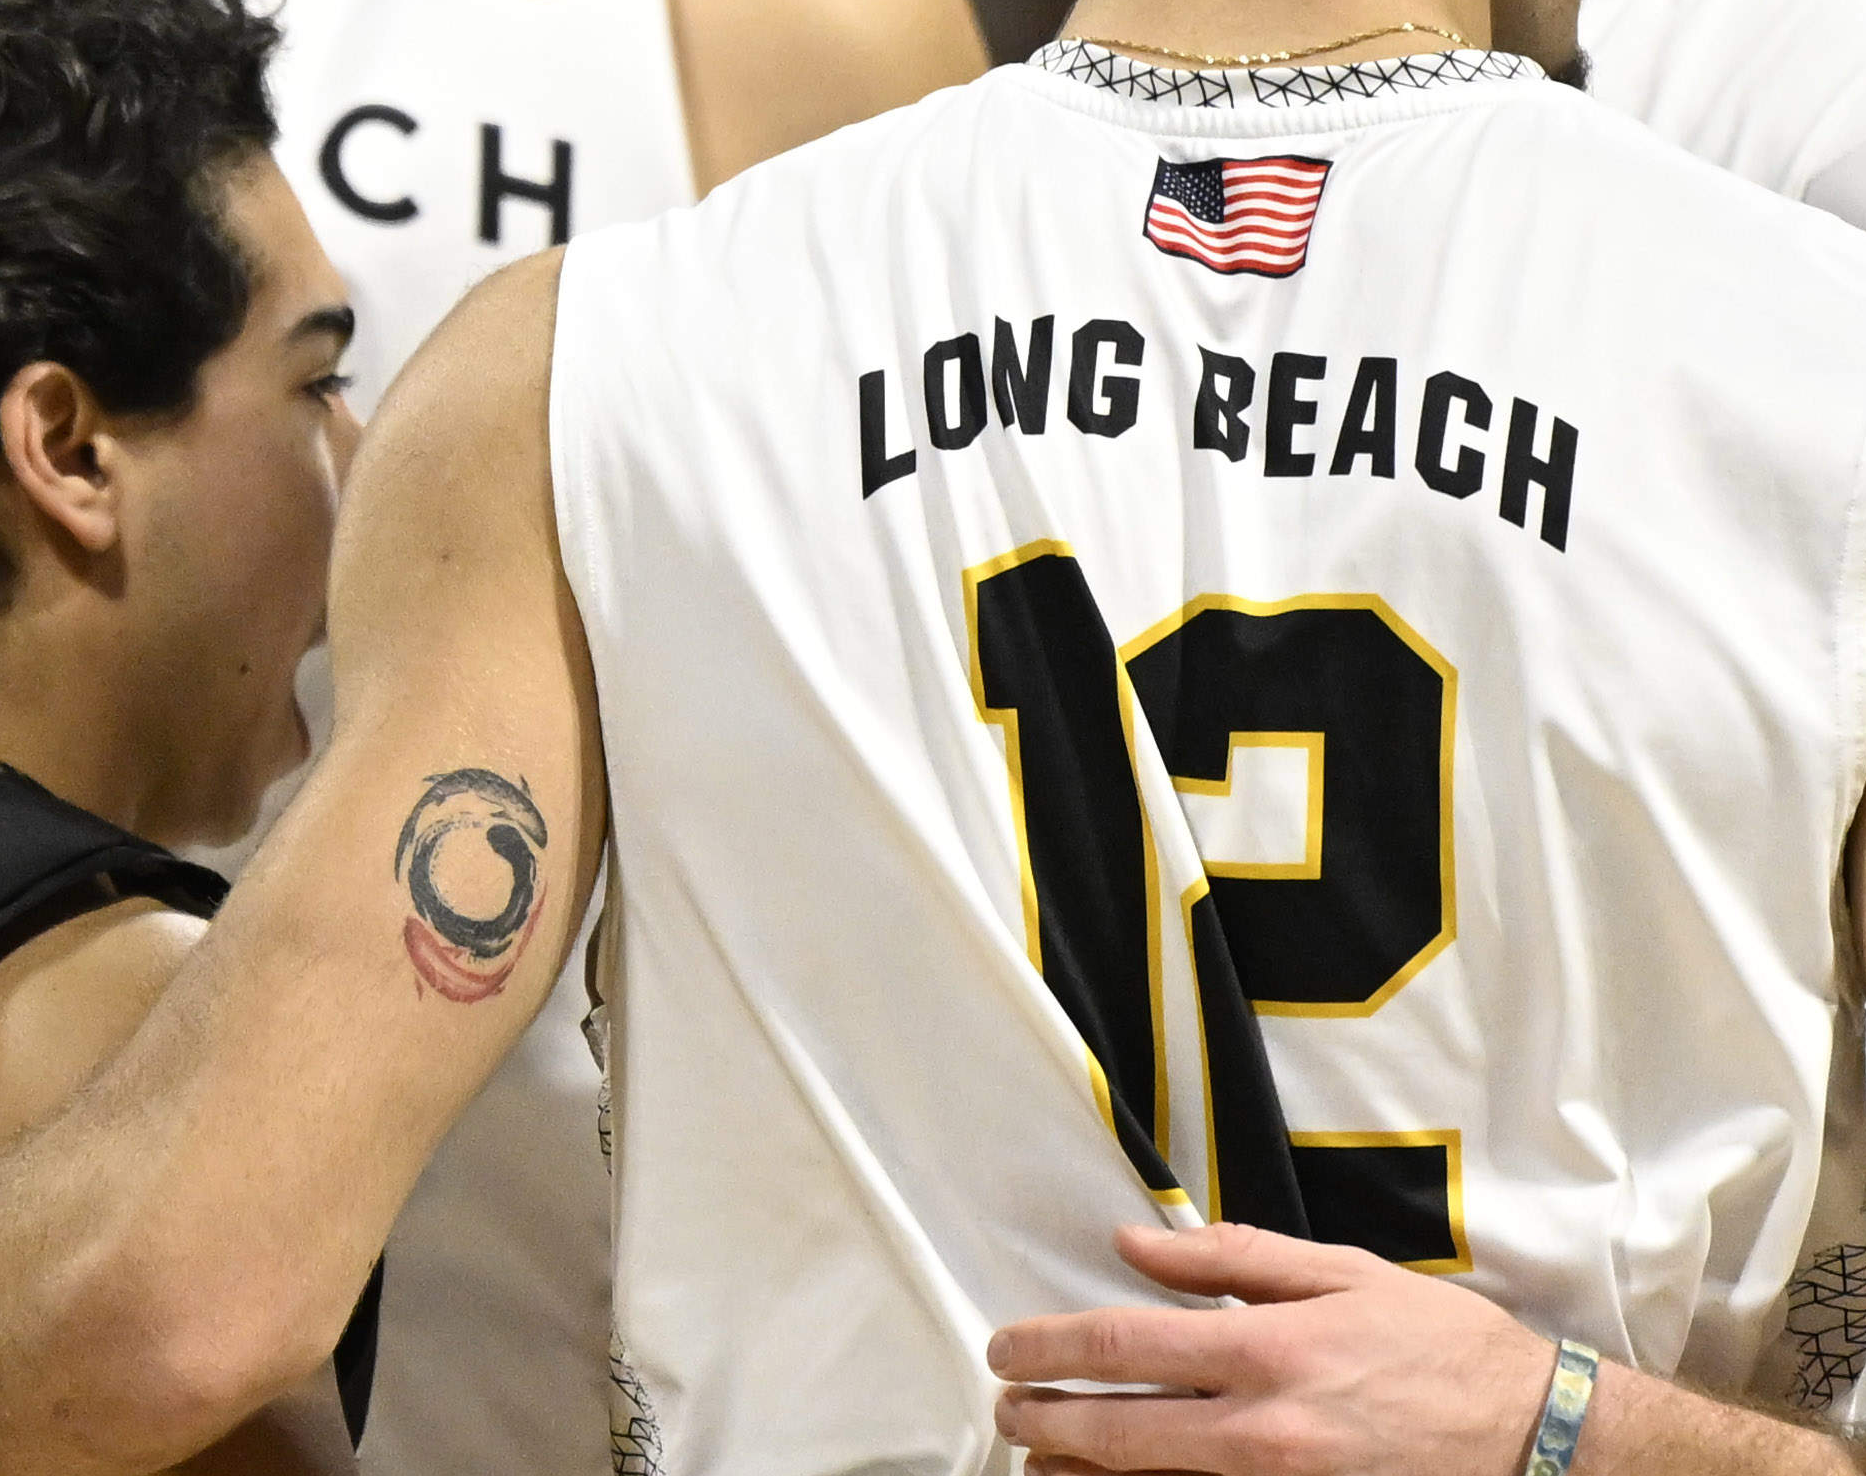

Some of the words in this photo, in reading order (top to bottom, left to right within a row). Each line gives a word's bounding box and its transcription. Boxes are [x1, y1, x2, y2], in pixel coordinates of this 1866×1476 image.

[858, 314, 1145, 501] LONG
[1194, 341, 1579, 554] BEACH
[962, 537, 1473, 1273] 12
